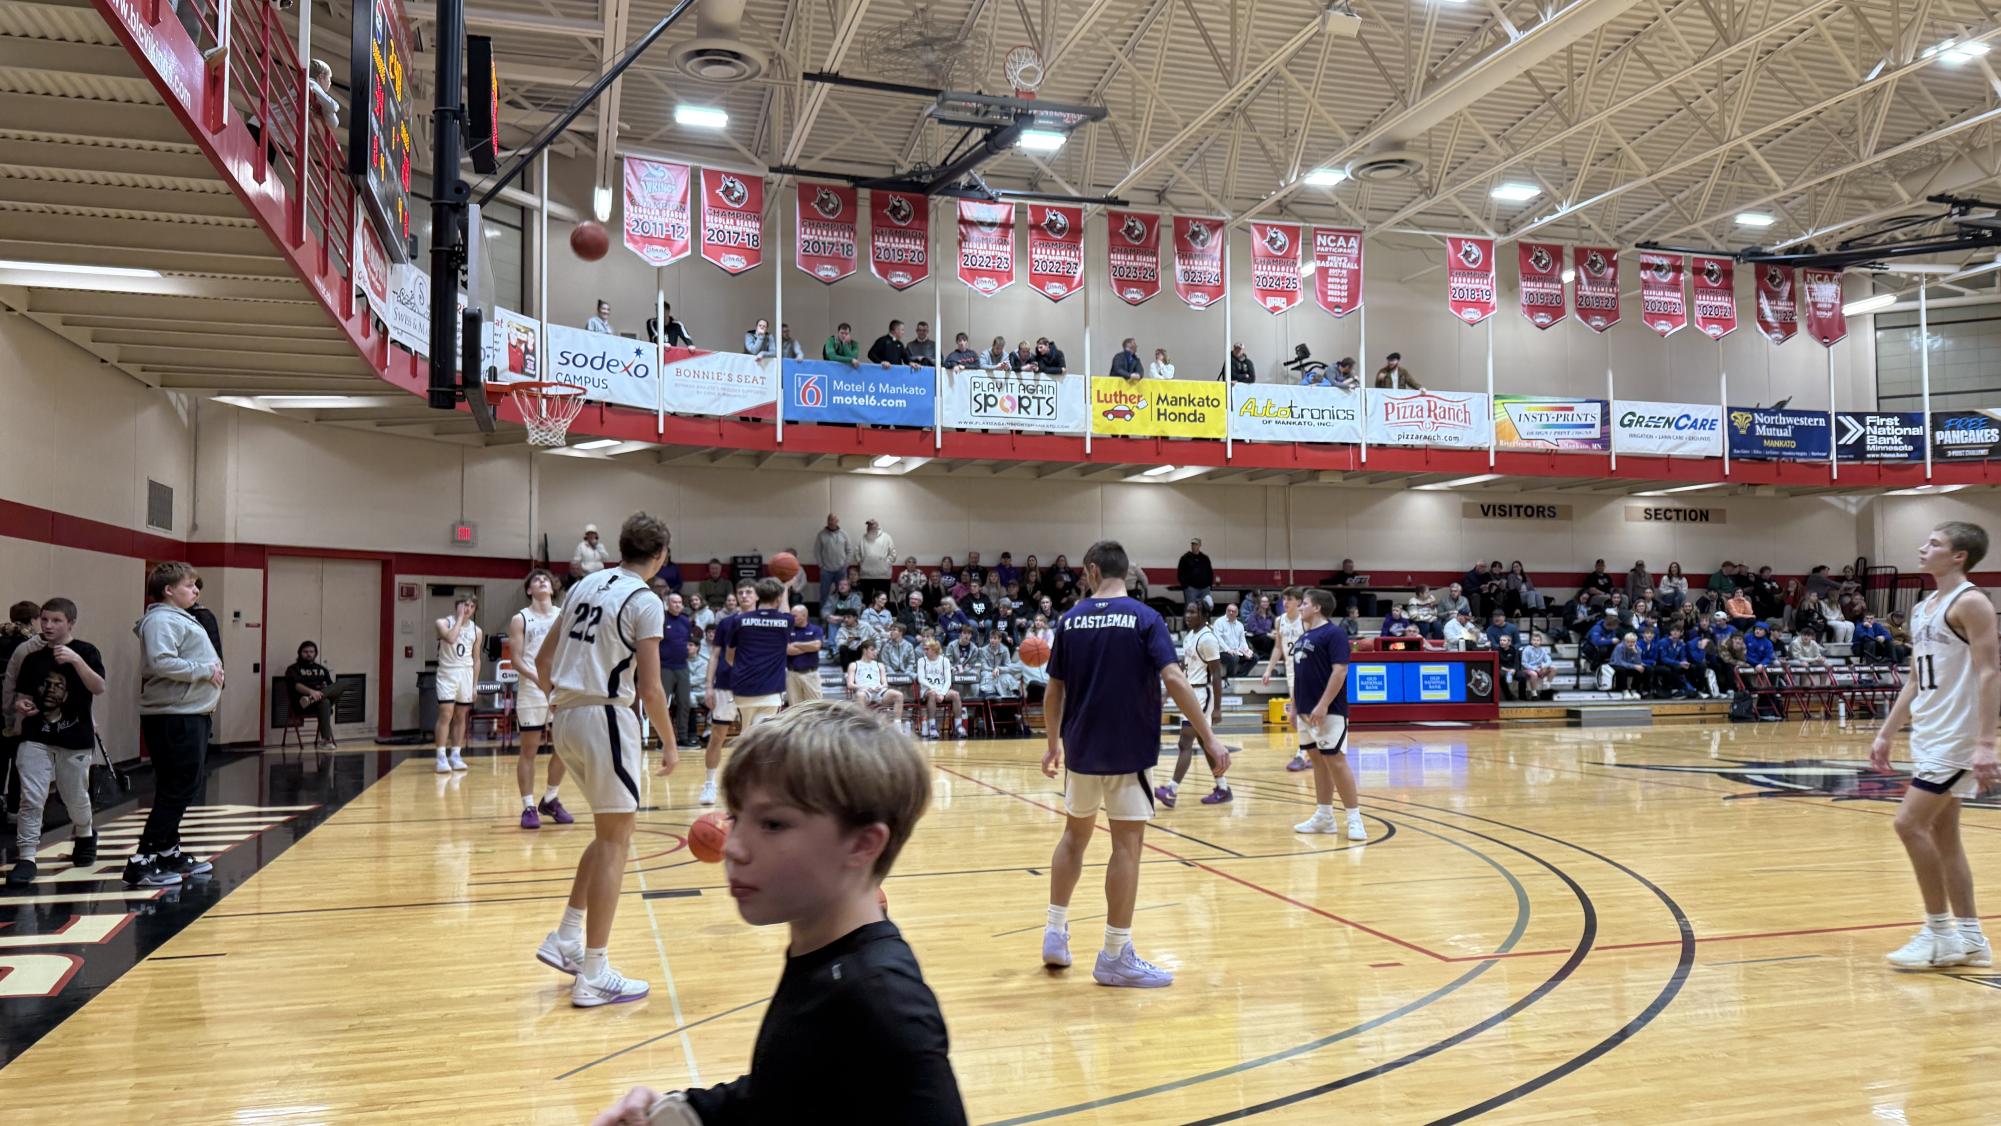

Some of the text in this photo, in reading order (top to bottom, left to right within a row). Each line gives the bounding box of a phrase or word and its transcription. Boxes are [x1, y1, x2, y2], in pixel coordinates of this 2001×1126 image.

[706, 208, 760, 221] CHAMPION
[631, 219, 686, 240] 2011-12
[801, 220, 854, 231] CHAMPION
[706, 228, 760, 248] 2017-18
[801, 227, 854, 240] TOURNAMENT
[875, 228, 925, 239] CHAMPION
[801, 240, 854, 257] 2017-18
[988, 244, 1010, 253] SEASON
[1032, 240, 1080, 251] CHAMPION
[1316, 234, 1358, 249] NCAA
[875, 247, 925, 263] 2019-20
[1110, 253, 1157, 263] REGULAR SEASON
[1111, 247, 1156, 257] CHAMPION
[963, 254, 1010, 269] 2022-23
[1033, 260, 1079, 275] 2022-23
[1254, 257, 1298, 268] CHAMPION
[1316, 260, 1359, 270] BASKETBALL
[1112, 265, 1156, 280] 2023-24
[1178, 270, 1220, 284] 2023-24
[1806, 273, 1840, 285] NCAA
[1255, 275, 1299, 289] 2024-25
[1451, 287, 1492, 301] 2018-19
[1525, 291, 1563, 306] 2019-20
[1578, 295, 1617, 310] 2019-20
[1644, 299, 1683, 313] 2020-21
[1697, 303, 1733, 317] 2020-21
[557, 350, 649, 379] sodexo
[555, 372, 608, 390] CAMPUS
[675, 367, 767, 386] BONNIE'S SEAT
[833, 380, 927, 397] Motel 6 Mankato
[973, 381, 1055, 396] PLAY IT AGAIN
[832, 395, 907, 408] motel6.com
[973, 393, 1055, 416] SPORTS
[1096, 389, 1143, 405] Luther
[1156, 393, 1220, 408] Mankato
[1157, 408, 1205, 423] Honda
[1238, 397, 1355, 420] Autotronics
[1384, 399, 1472, 425] Pizza Ranch
[1518, 413, 1597, 423] INSTY-PRINTS
[1754, 413, 1826, 427] Northwestern
[1866, 415, 1900, 426] First
[1944, 416, 1990, 430] FREE
[1397, 432, 1460, 442] pizzaranch.com
[1755, 425, 1792, 437] Mutual
[1866, 426, 1924, 436] National
[1935, 428, 2000, 445] PANCAKES
[1763, 439, 1797, 448] MANKATO
[1866, 435, 1904, 445] Bank
[1480, 503, 1710, 523] VISITORS SECTION
[568, 603, 603, 644] 22
[1074, 613, 1137, 630] CASTLEMAN
[456, 643, 466, 658] 0
[1917, 654, 1938, 691] 11
